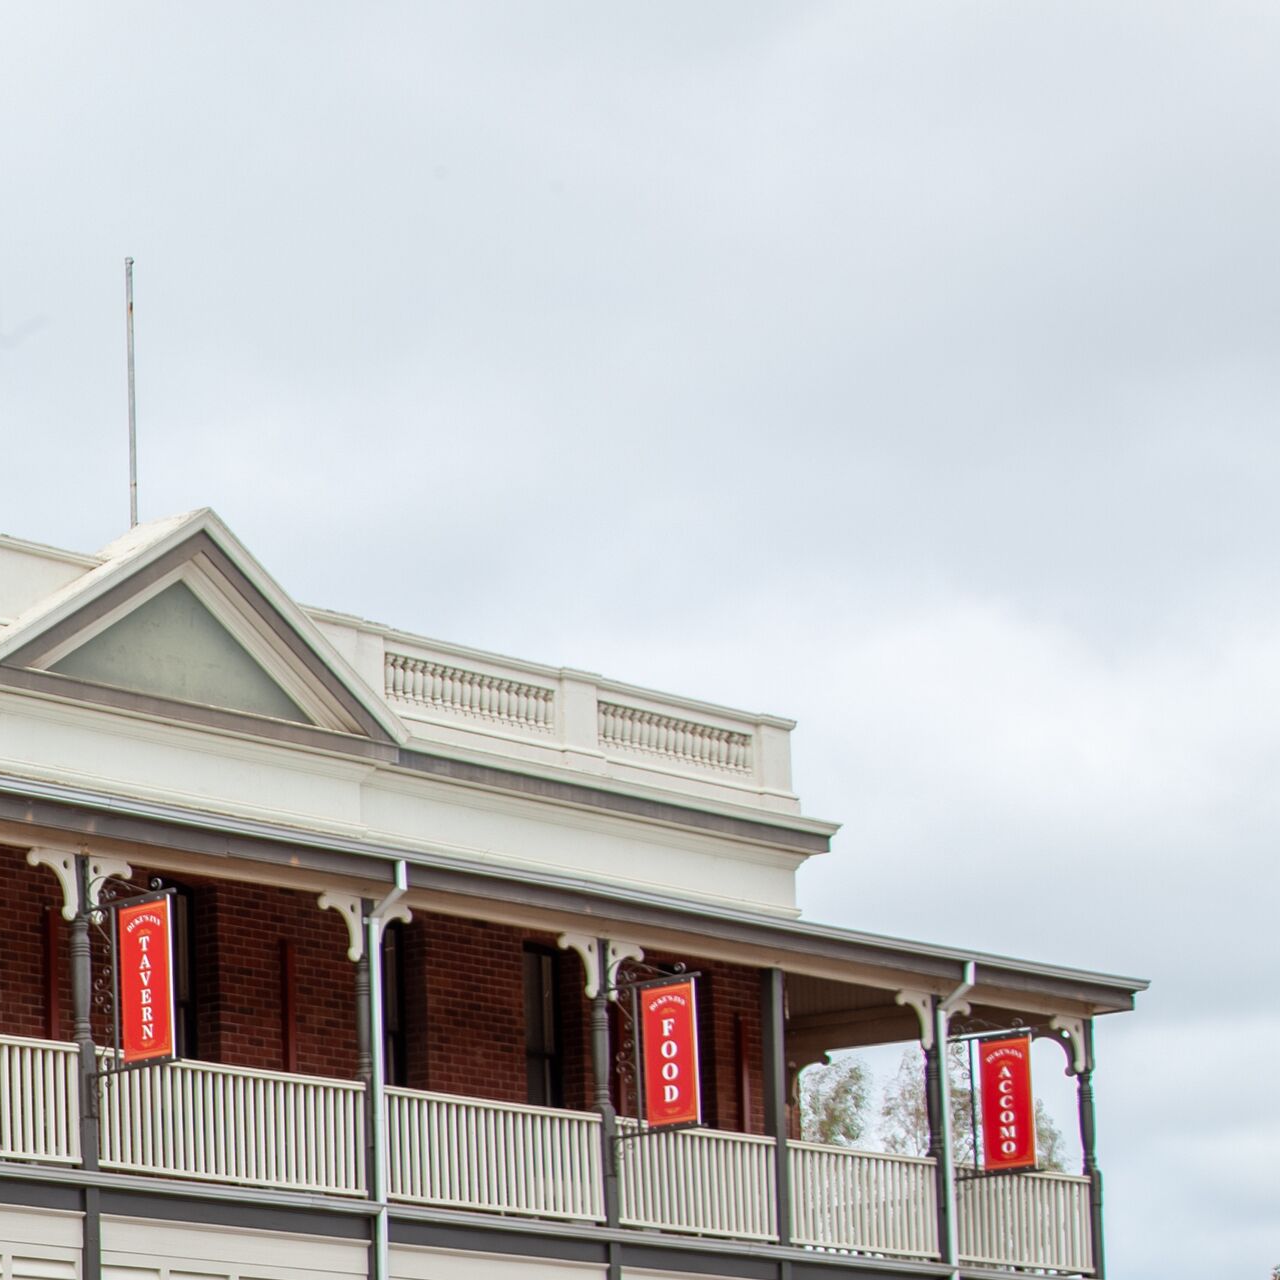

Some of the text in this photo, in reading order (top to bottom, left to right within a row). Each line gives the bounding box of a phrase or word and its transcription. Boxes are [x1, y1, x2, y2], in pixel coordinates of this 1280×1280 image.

[139, 935, 153, 1040] TAVERN
[661, 1018, 679, 1103] FOOD
[998, 1066, 1016, 1153] ACCOMO
